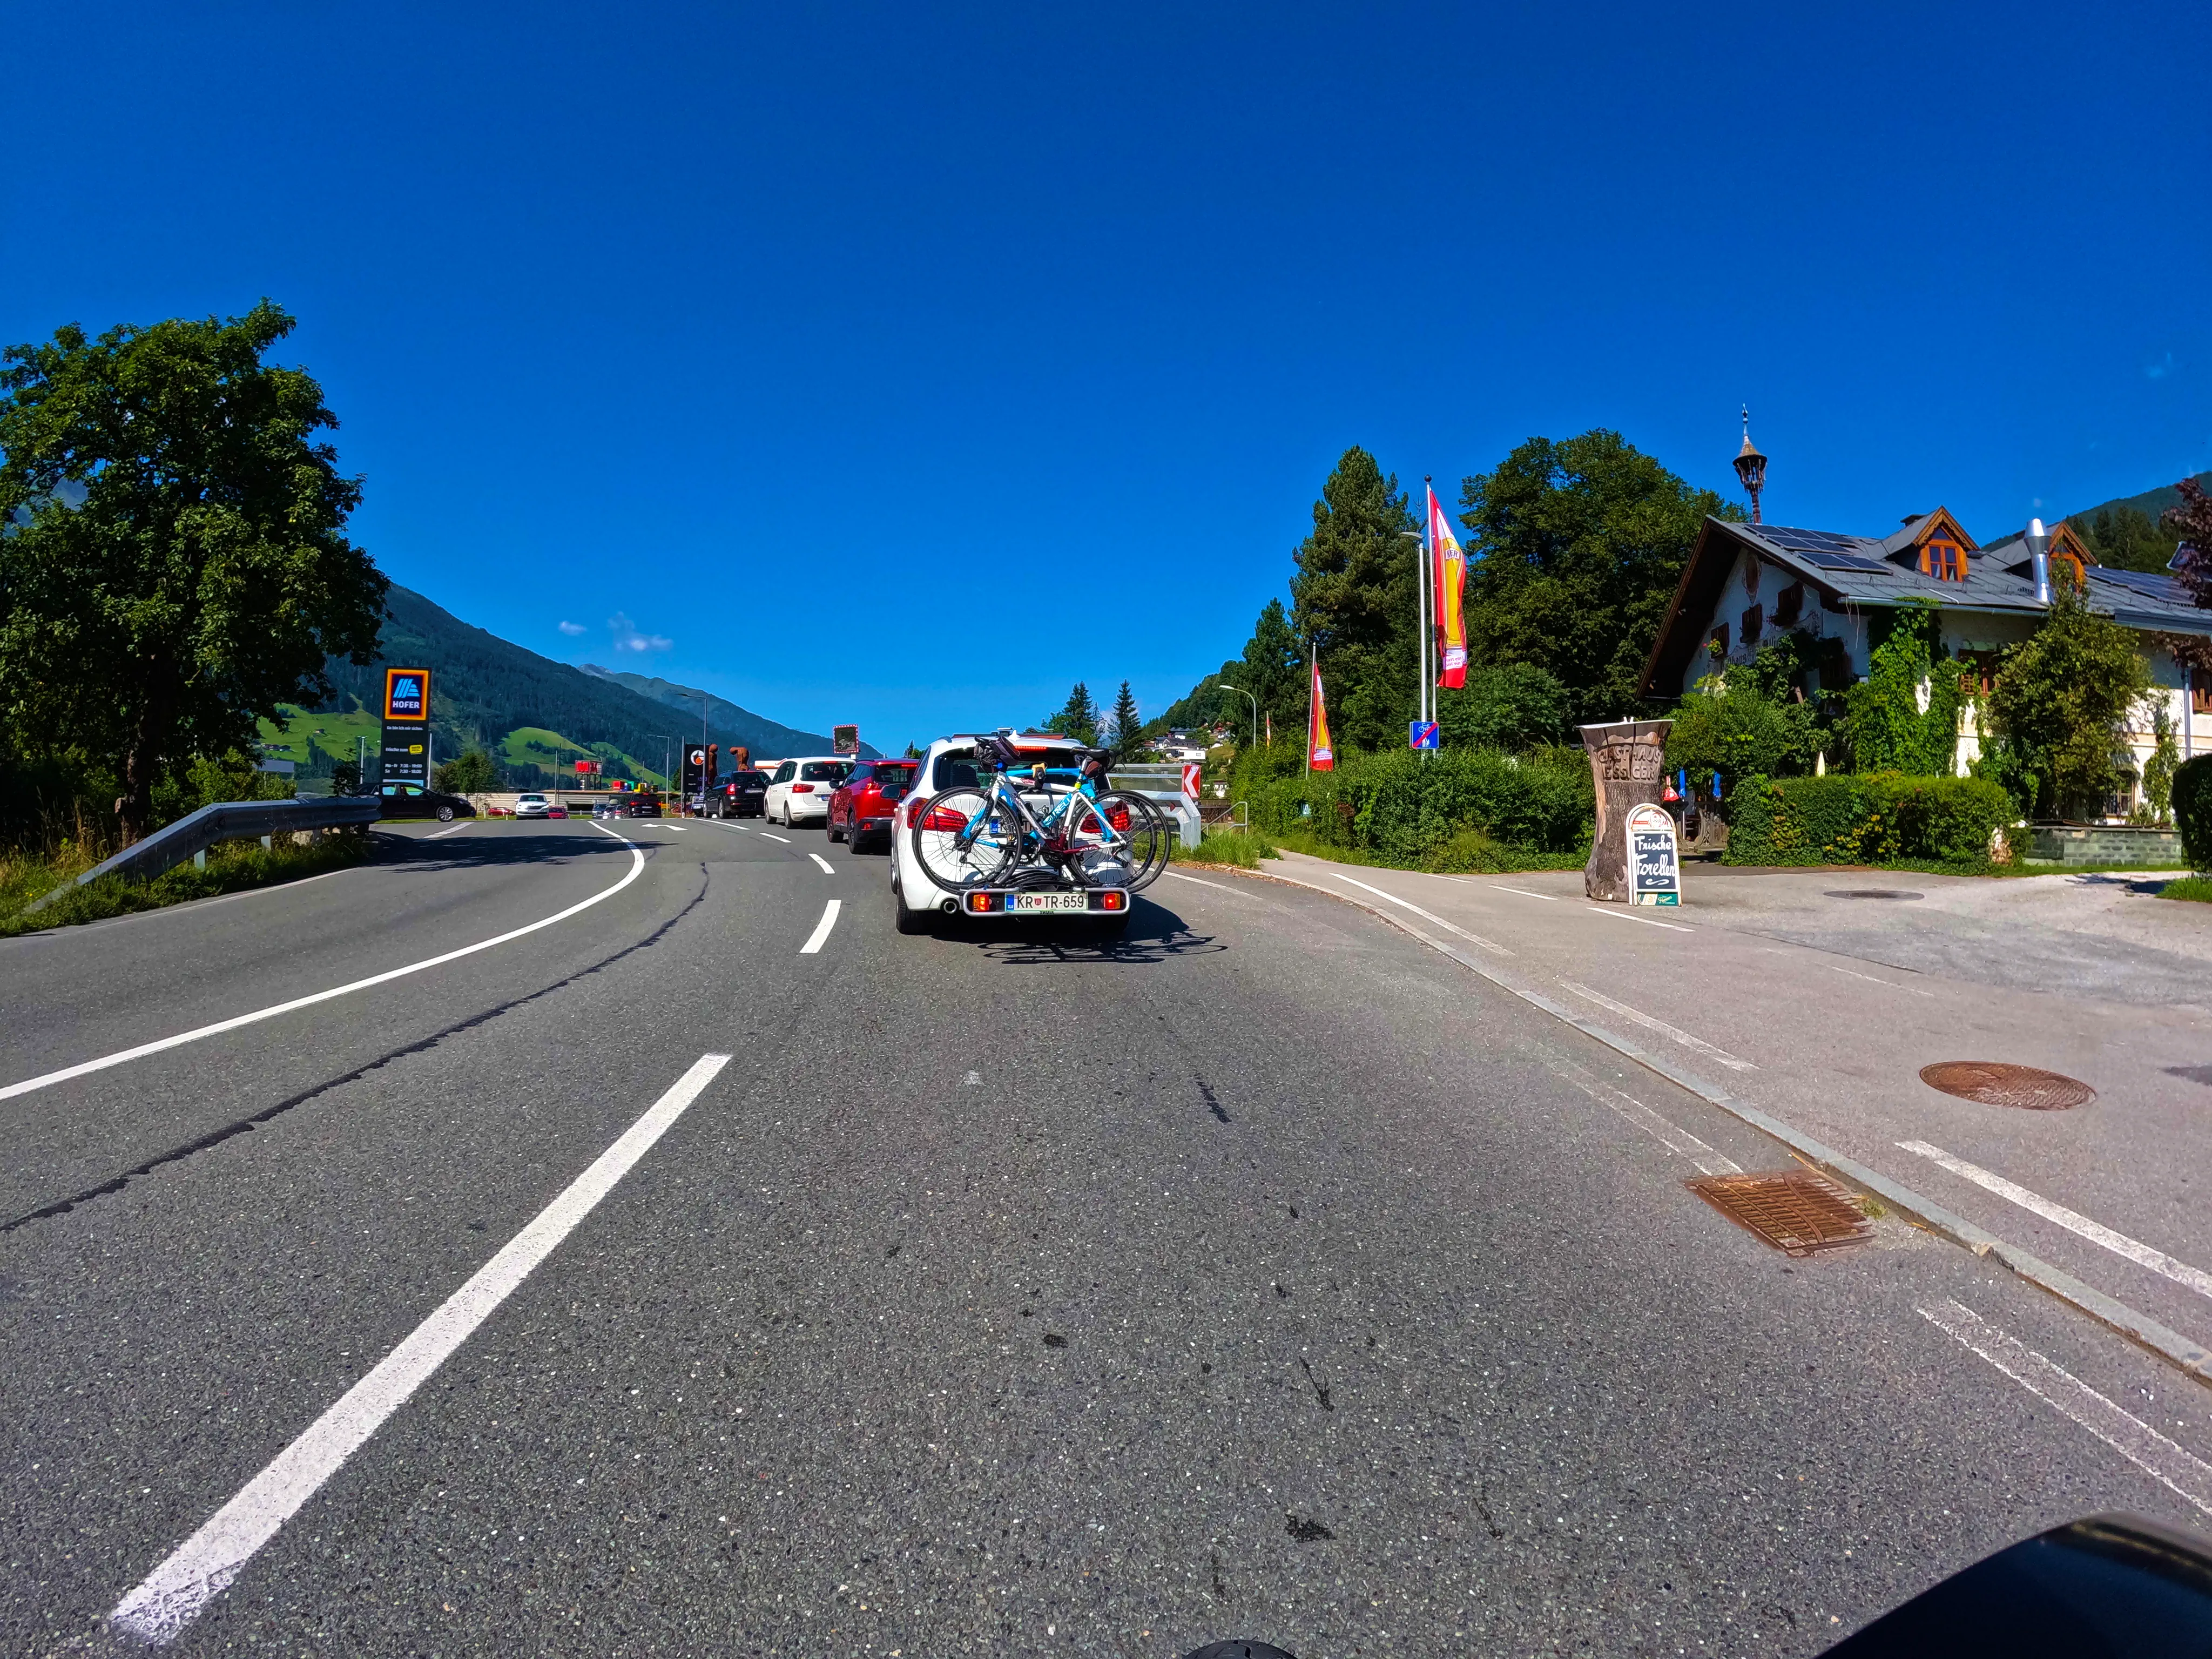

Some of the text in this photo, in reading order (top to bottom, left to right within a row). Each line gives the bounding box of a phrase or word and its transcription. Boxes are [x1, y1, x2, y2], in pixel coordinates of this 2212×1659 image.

[1635, 834, 1672, 851] Frische
[1636, 853, 1675, 876] Forellen
[1017, 896, 1033, 908] KR
[1043, 895, 1084, 908] TR-659
